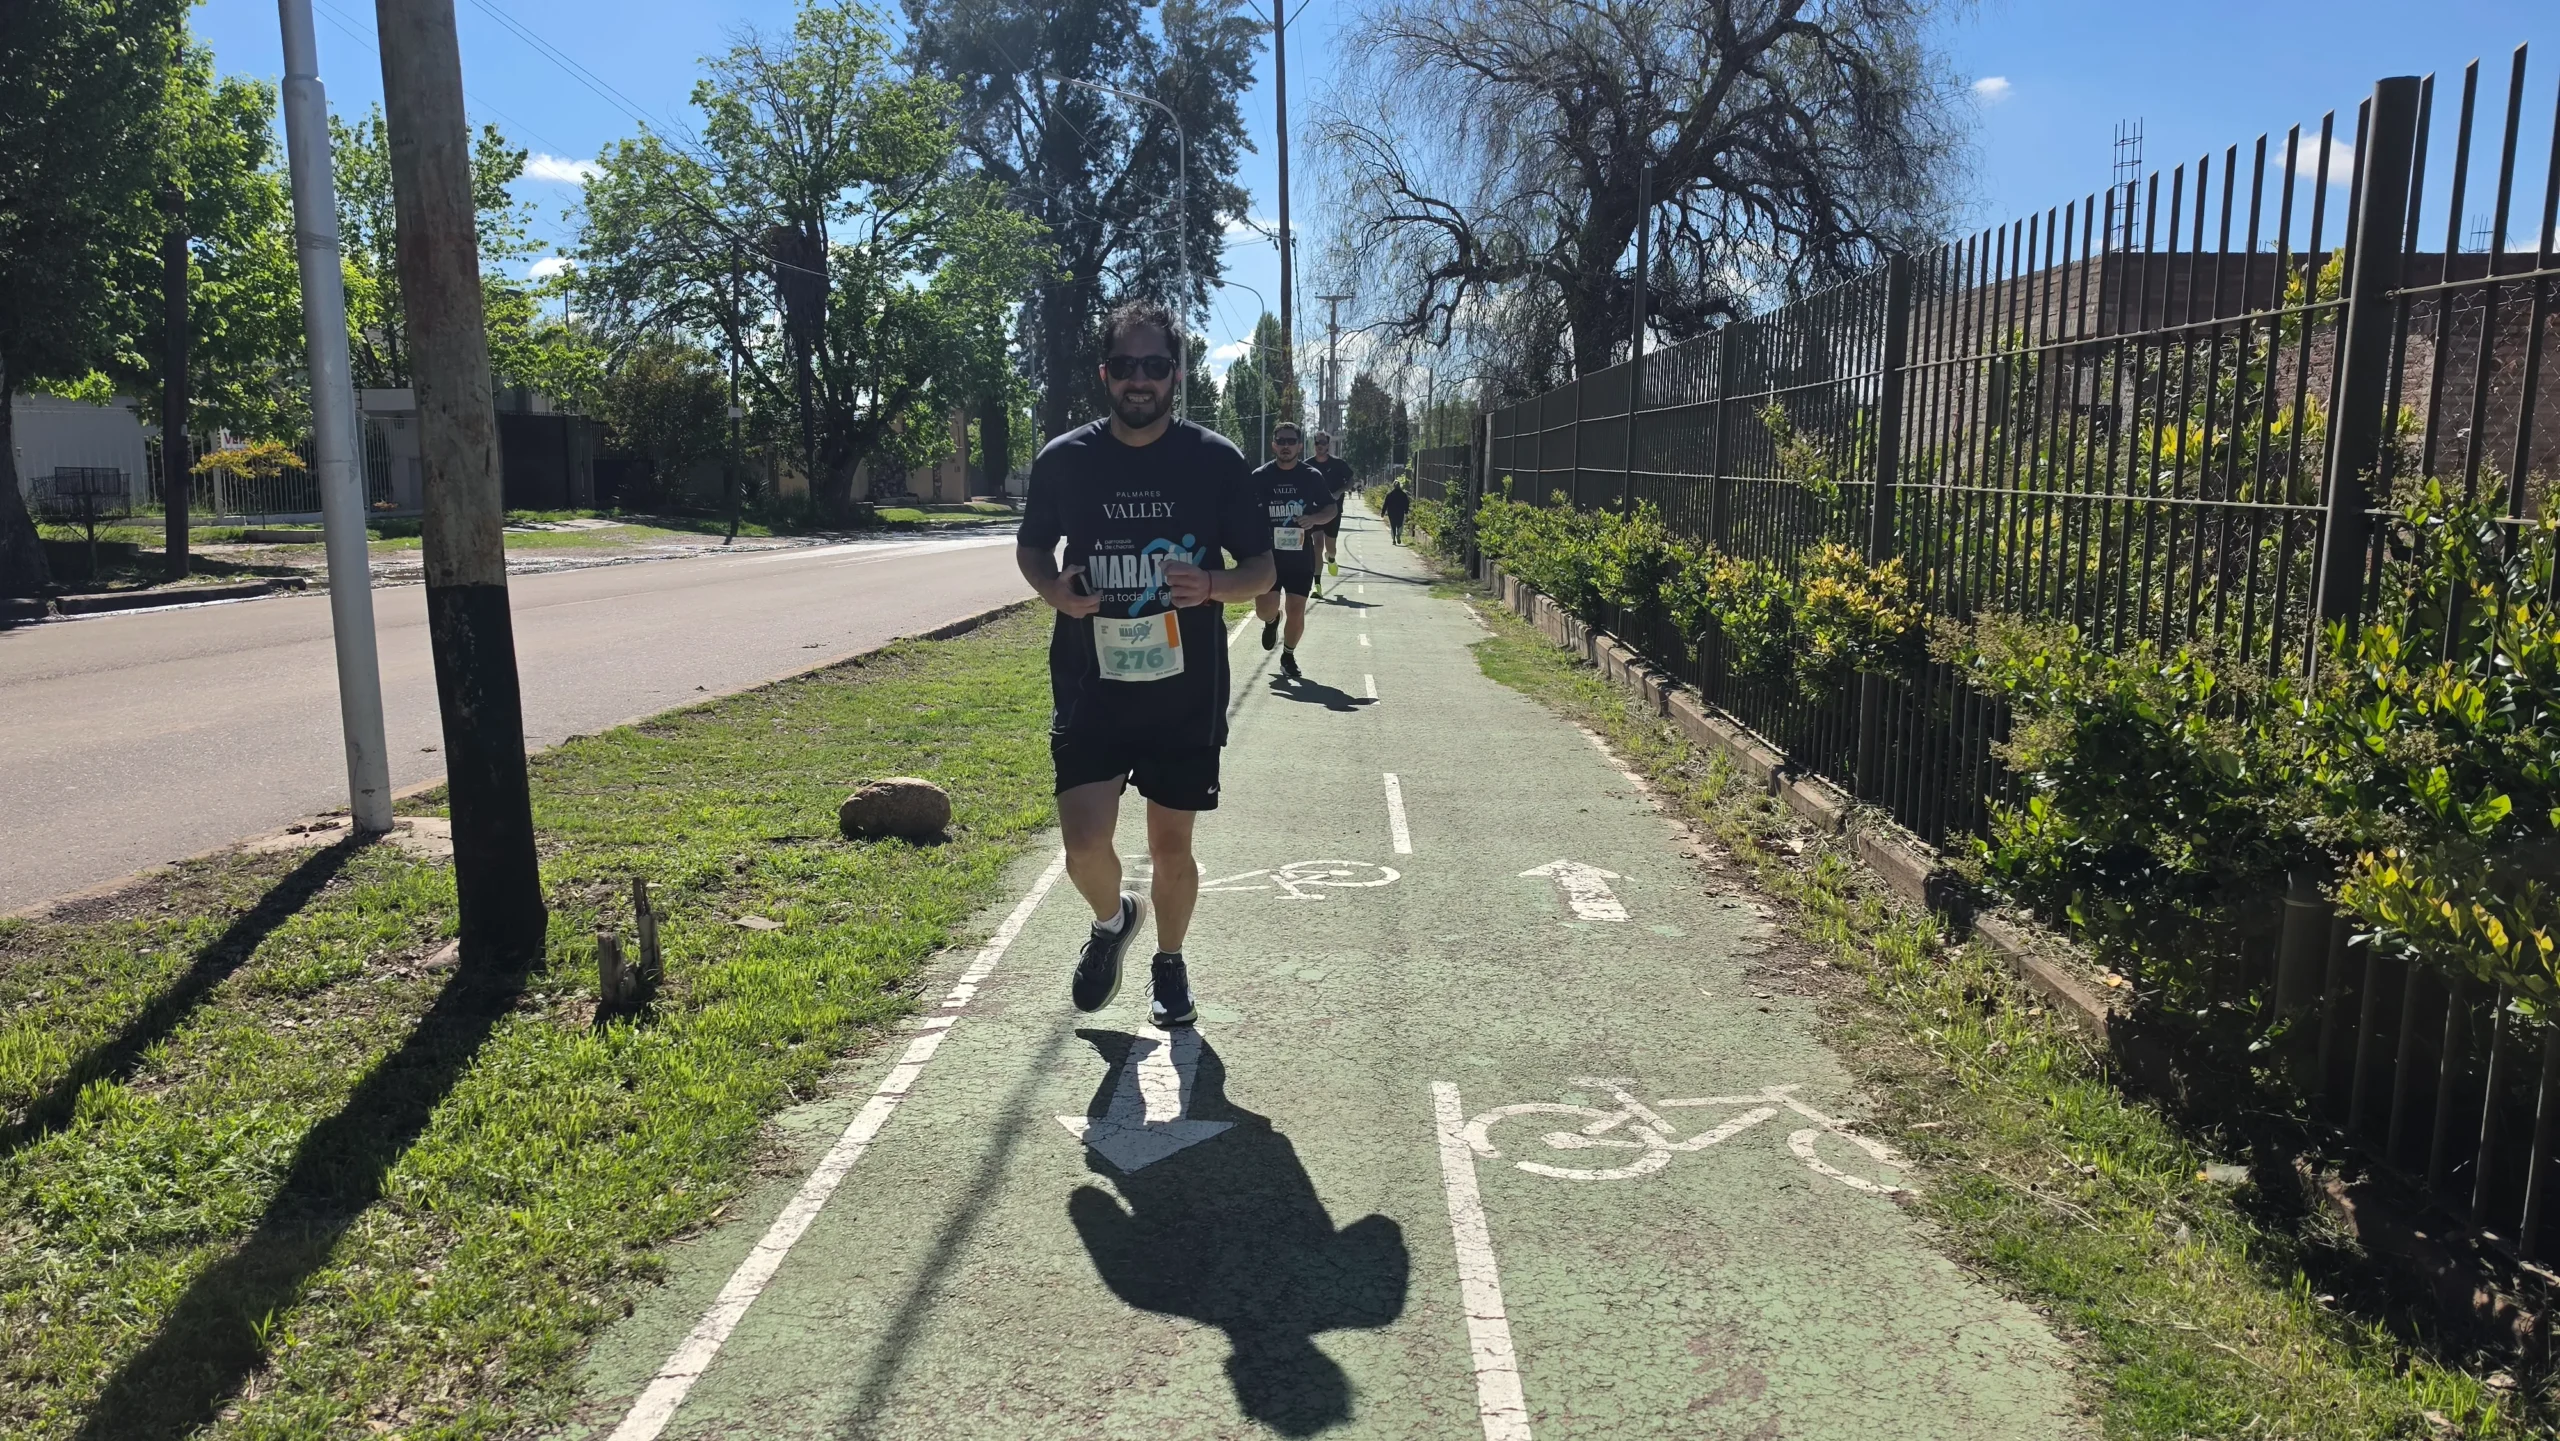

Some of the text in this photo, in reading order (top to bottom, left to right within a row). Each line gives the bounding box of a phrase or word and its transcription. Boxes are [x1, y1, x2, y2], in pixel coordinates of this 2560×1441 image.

[1116, 490, 1161, 498] PALMARES
[1102, 502, 1175, 519] VALLEY
[1099, 593, 1115, 602] ara
[1116, 591, 1144, 602] toda
[1146, 590, 1156, 601] la
[1113, 647, 1164, 670] 276
